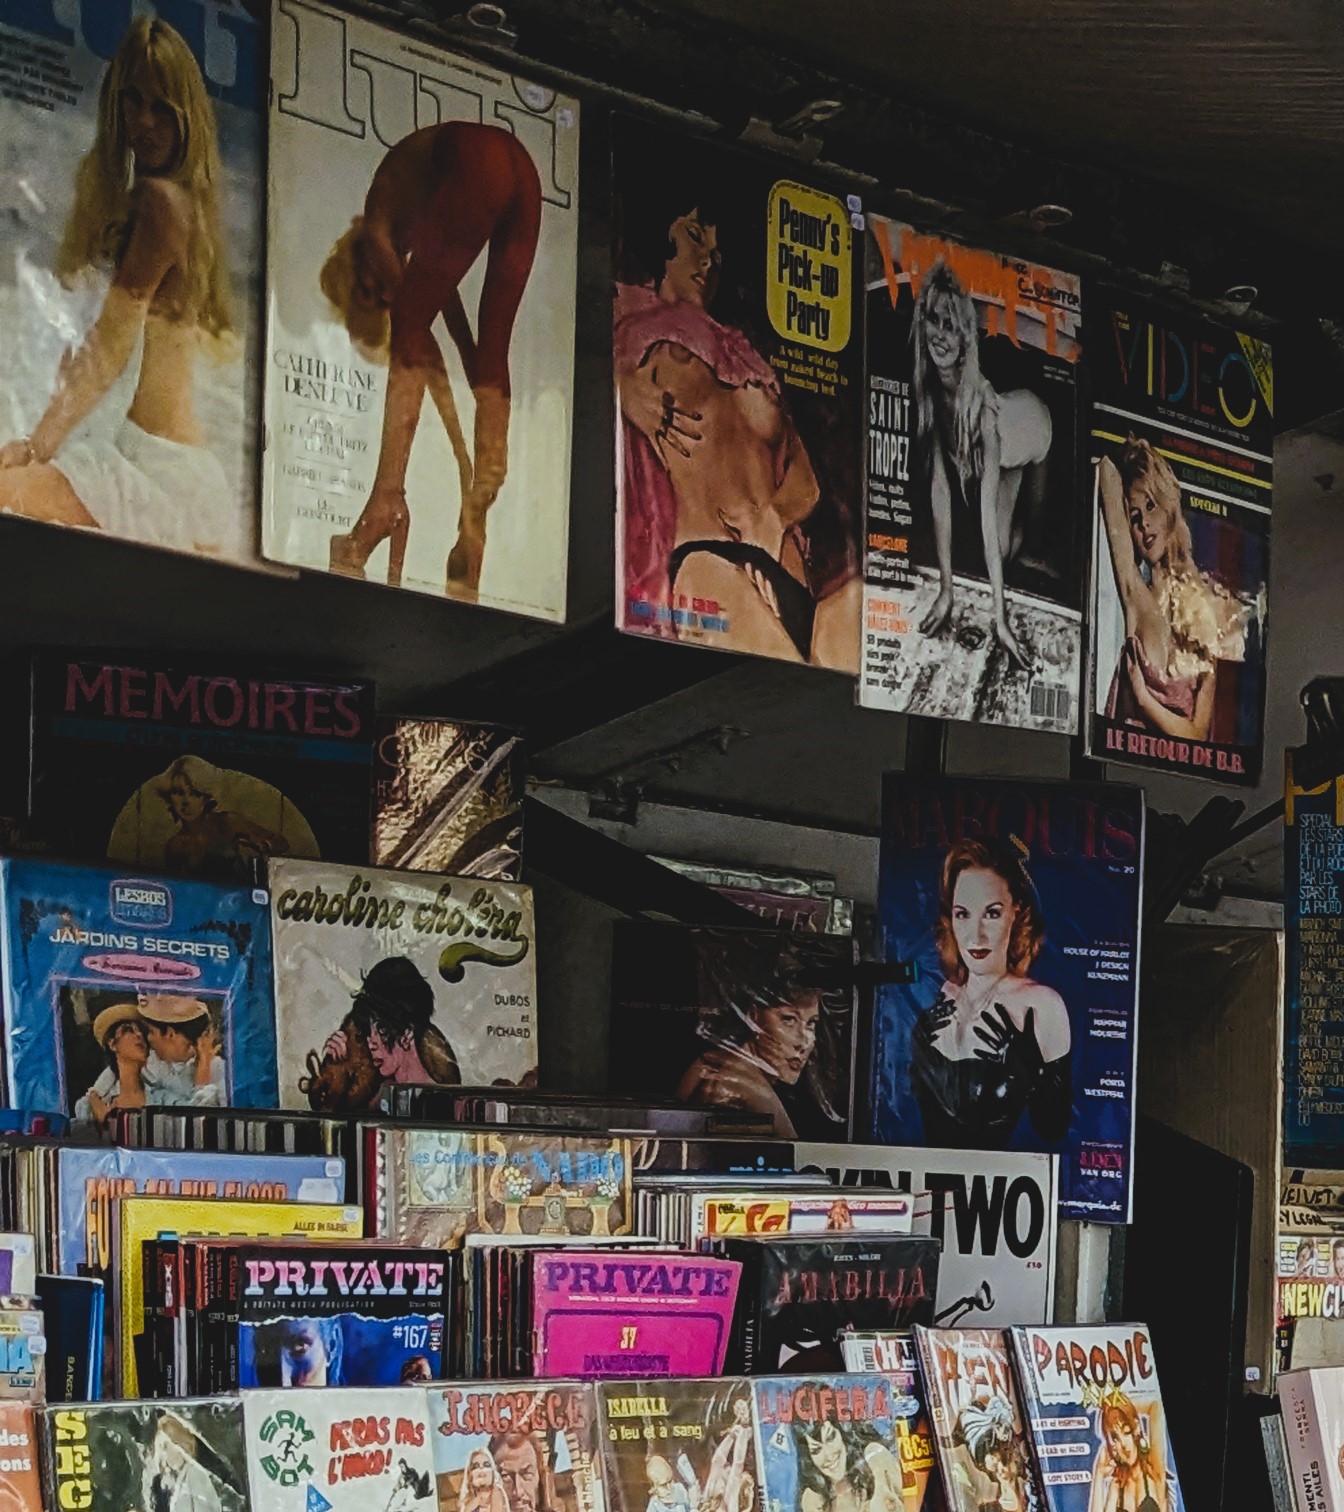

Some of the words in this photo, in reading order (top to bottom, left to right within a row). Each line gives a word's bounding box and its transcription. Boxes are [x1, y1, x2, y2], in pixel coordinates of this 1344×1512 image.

[779, 196, 841, 257] Penny's
[778, 241, 840, 299] Pick-up
[786, 290, 831, 342] Party
[869, 391, 911, 432] SAINT
[869, 430, 910, 482] TROPEZ
[1106, 727, 1124, 750] LE
[1126, 731, 1191, 764] RETOUR
[1193, 743, 1213, 768] DE
[277, 874, 406, 933] caroline
[49, 928, 138, 951] JARDINS
[143, 937, 230, 959] SECRETS
[494, 993, 531, 1008] DUBOS
[485, 1025, 531, 1039] PICHARD
[925, 1172, 1045, 1262] TWO
[244, 1260, 444, 1296] PRIVATE
[543, 1261, 733, 1297] PRIVATE
[392, 1325, 428, 1349] #167
[1032, 1330, 1153, 1389] PARODIE
[607, 1397, 669, 1417] ISABELLA
[758, 1388, 890, 1424] LUCIFERA
[0, 1429, 30, 1446] des
[258, 1409, 318, 1444] SAM
[620, 1423, 640, 1441] feu
[673, 1424, 702, 1441] sang
